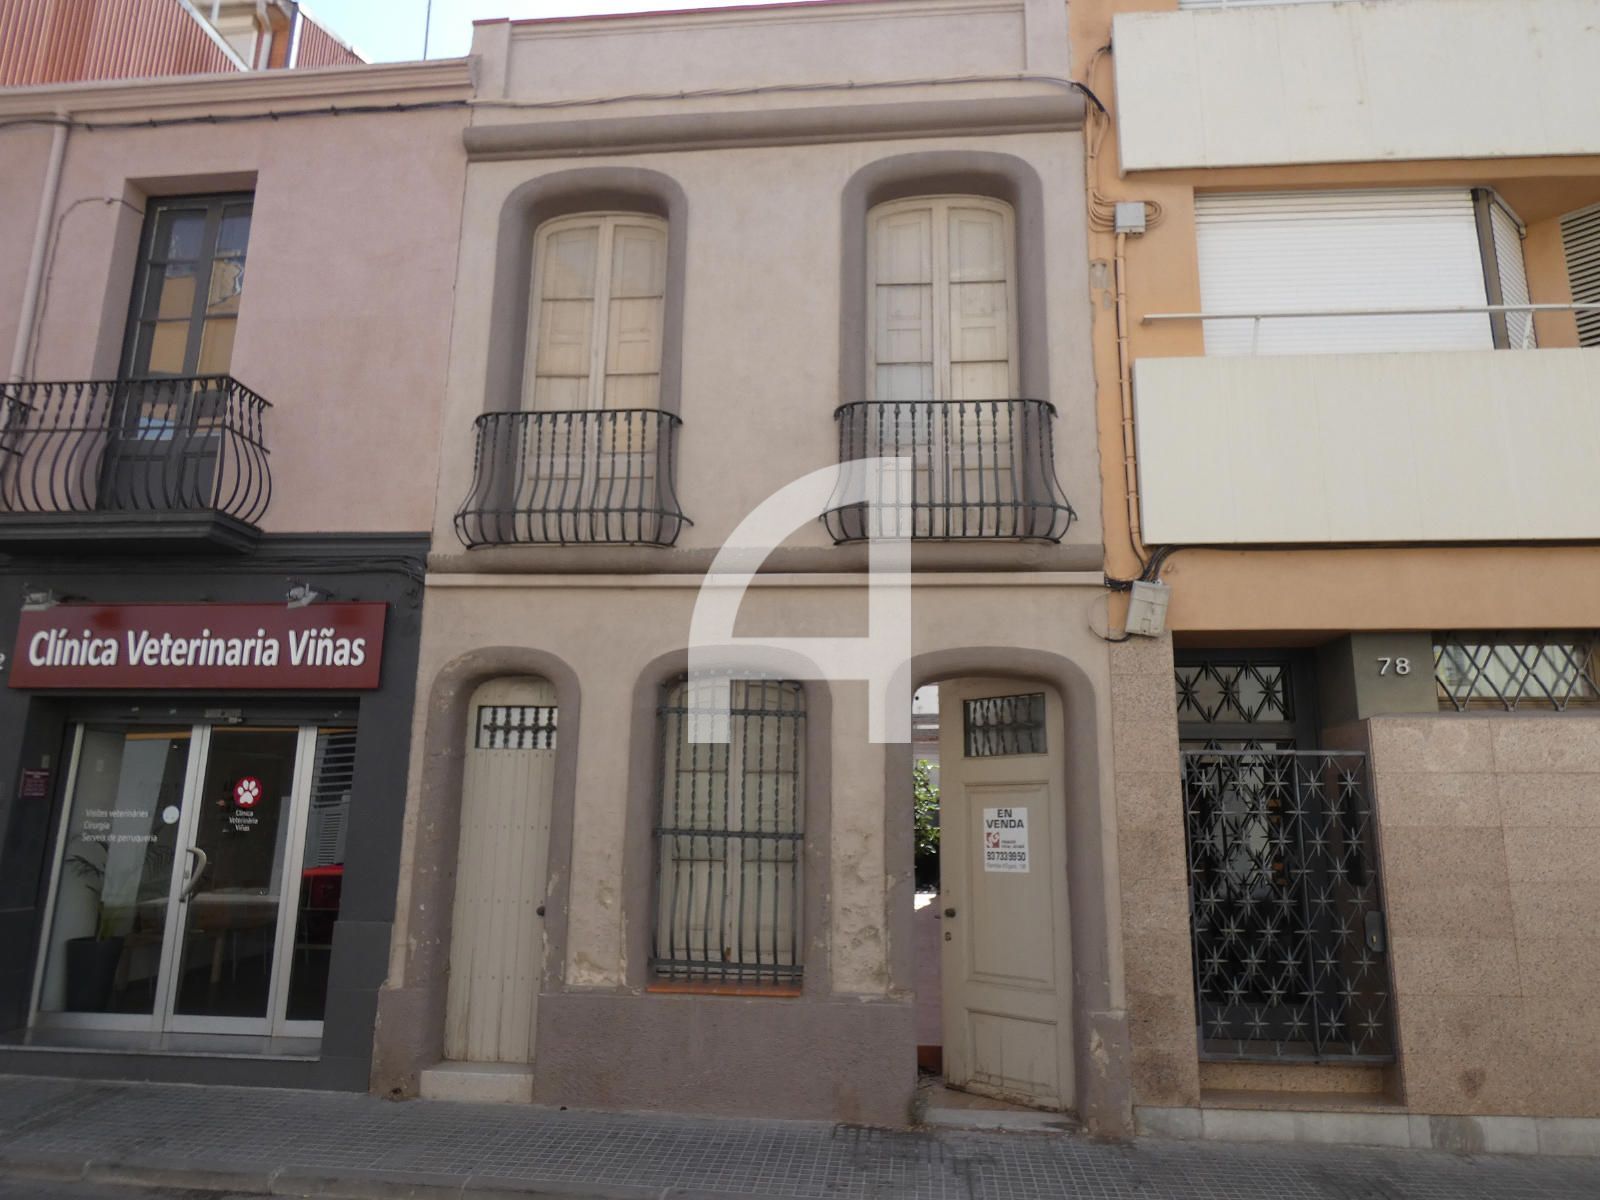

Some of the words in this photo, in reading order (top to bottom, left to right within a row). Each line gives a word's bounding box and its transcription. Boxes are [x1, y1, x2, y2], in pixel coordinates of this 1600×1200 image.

[28, 628, 119, 667] Clínica
[127, 628, 280, 667] Veterinaria
[288, 627, 367, 667] Viñas
[1377, 657, 1410, 675] 78
[997, 809, 1012, 818] EN
[986, 819, 1024, 829] VENDA
